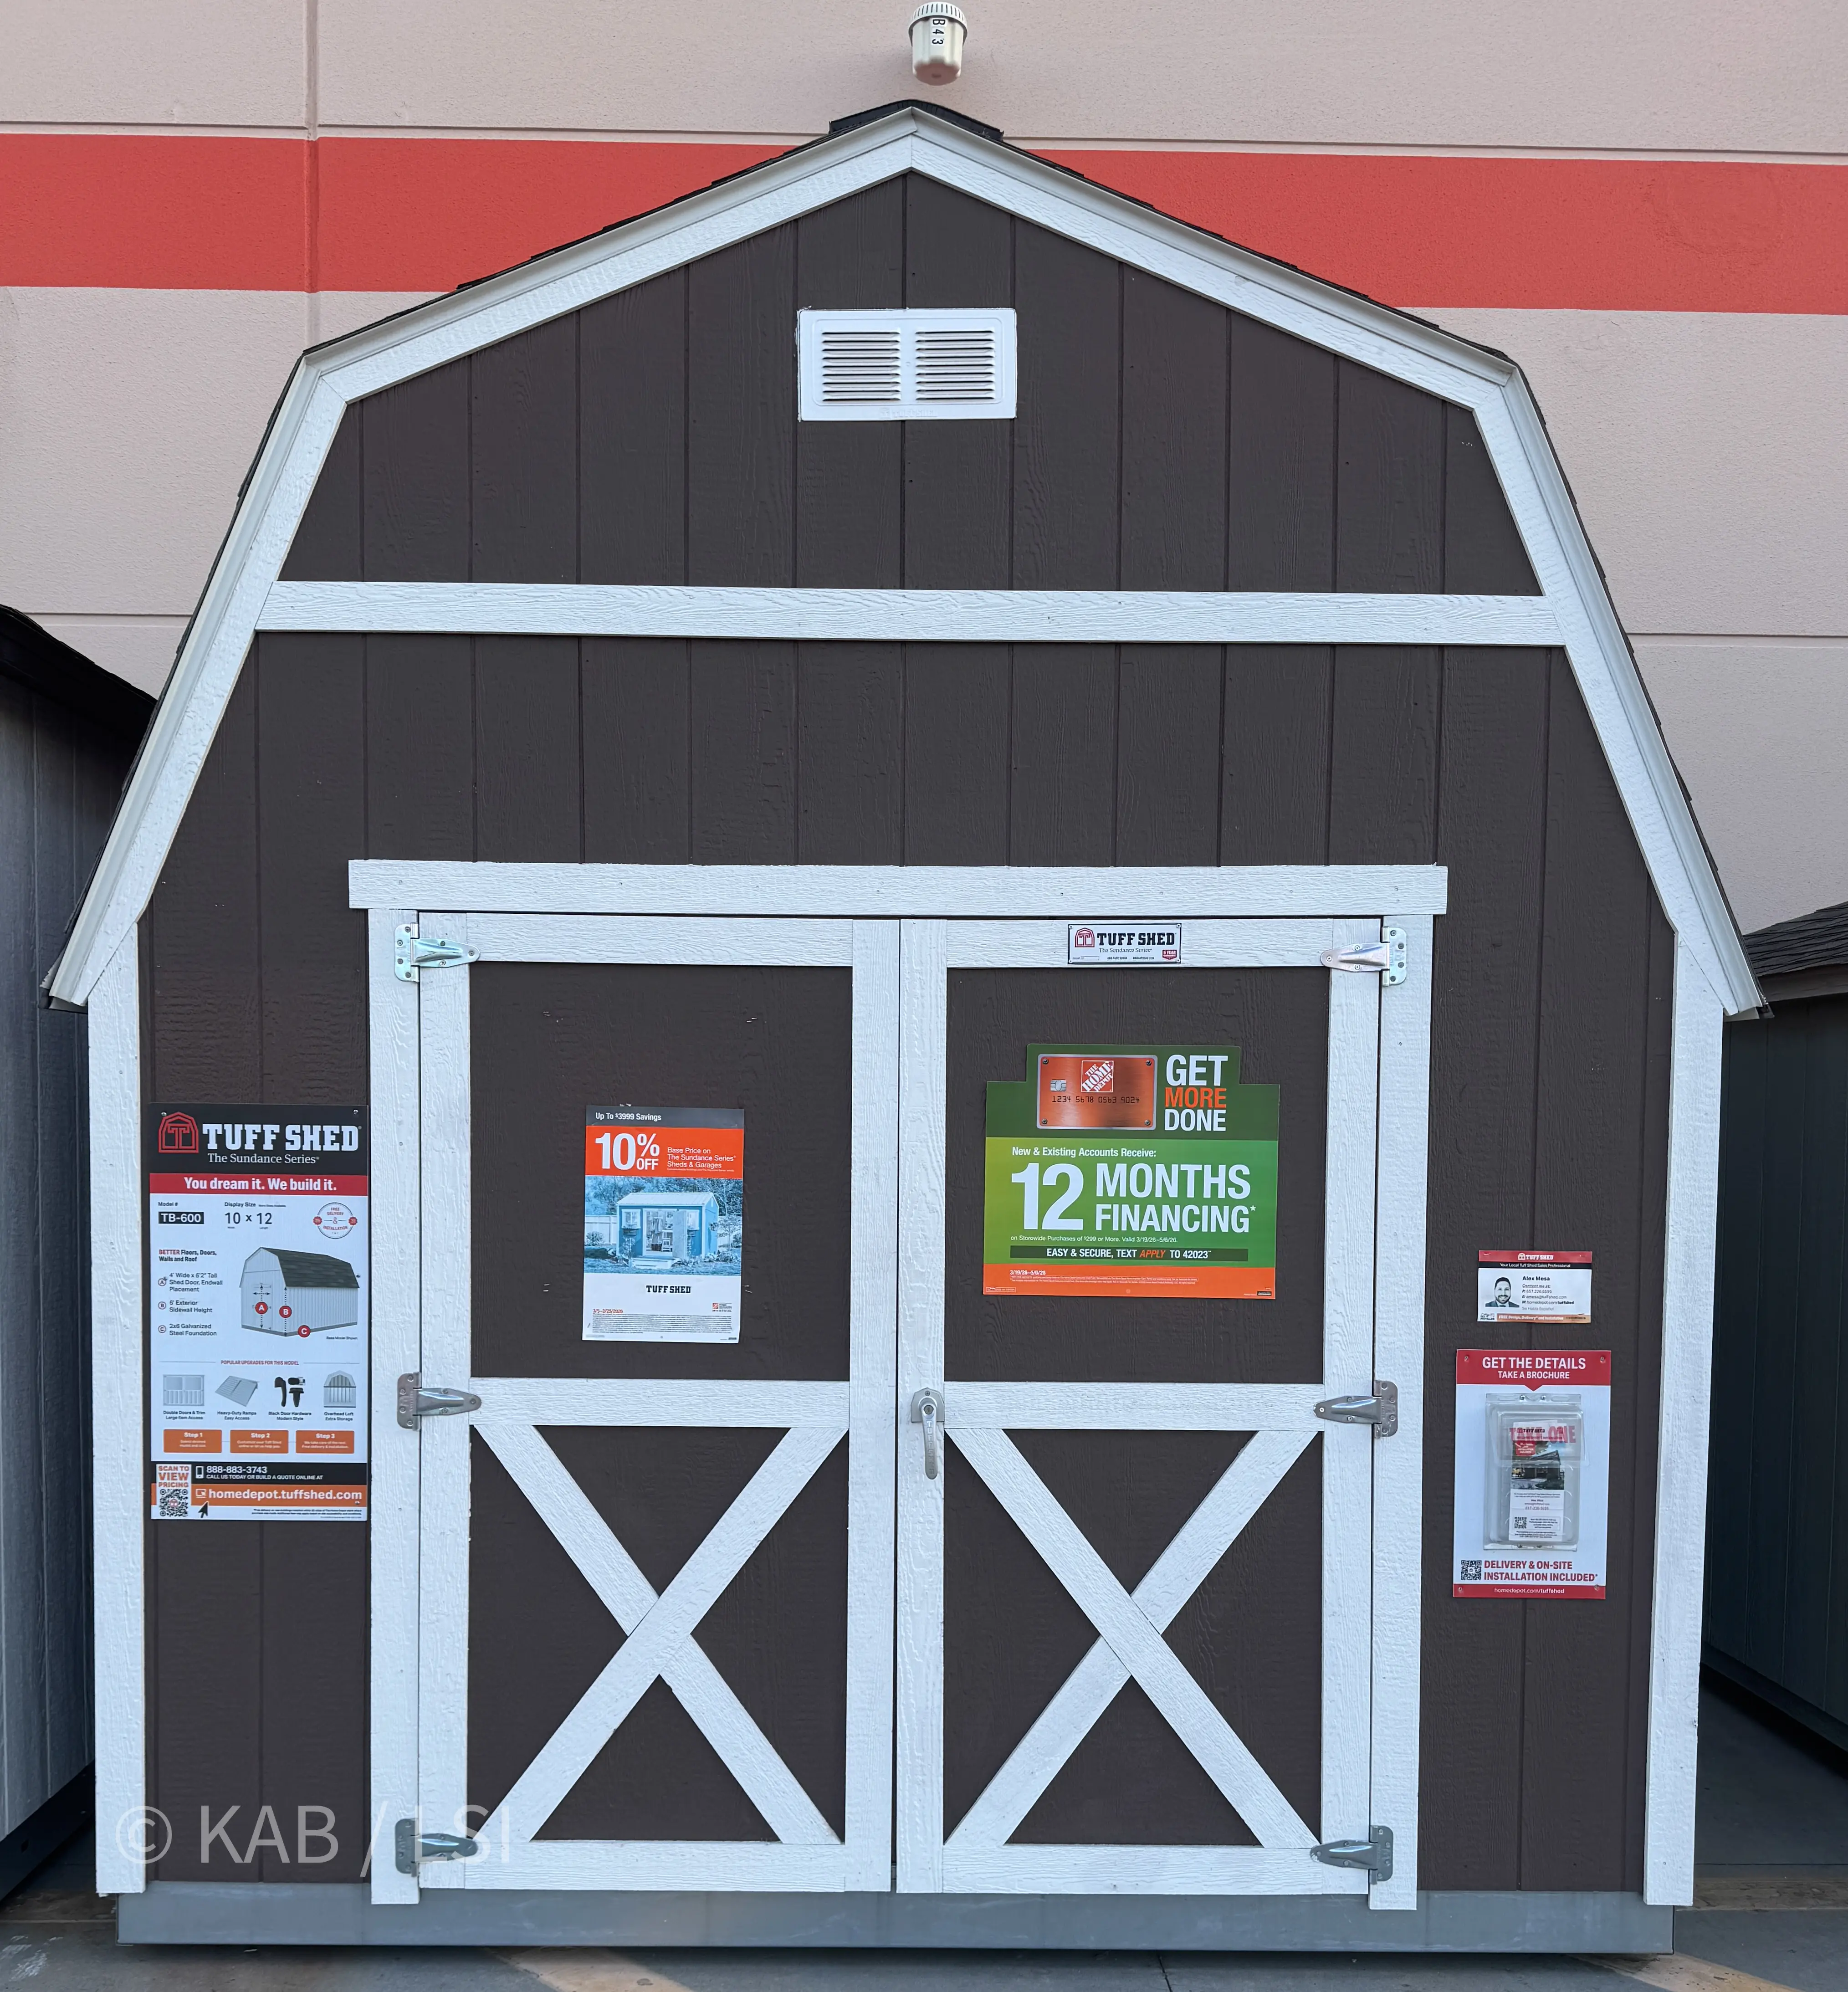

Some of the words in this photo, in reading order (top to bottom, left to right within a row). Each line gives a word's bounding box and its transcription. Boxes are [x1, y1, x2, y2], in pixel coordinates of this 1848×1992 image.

[932, 19, 946, 45] B43
[1097, 932, 1135, 946] TUFF
[1138, 932, 1175, 946] SHED
[1081, 1061, 1114, 1092] HOME
[1085, 1064, 1099, 1077] THE
[1166, 1055, 1228, 1086] GET
[1093, 1071, 1114, 1092] DEPOT
[1165, 1087, 1227, 1108] MORE
[636, 1113, 662, 1121] Savings
[1165, 1109, 1226, 1131] DONE
[203, 1123, 280, 1150] TUFF
[285, 1125, 358, 1152] SHED
[595, 1132, 660, 1170] 10%
[1012, 1147, 1031, 1156] New
[1033, 1147, 1040, 1156] &
[1042, 1147, 1076, 1158] Existing
[1078, 1147, 1119, 1157] Accounts
[1121, 1148, 1157, 1157] Receive:
[208, 1153, 228, 1163] The
[230, 1153, 282, 1163] Sundance
[636, 1158, 659, 1170] OFF
[184, 1177, 208, 1189] You
[210, 1178, 249, 1190] dream
[251, 1178, 265, 1190] it.
[267, 1178, 288, 1190] We
[290, 1178, 321, 1191] build
[323, 1179, 337, 1191] it.
[1096, 1163, 1251, 1200] MONTHS
[1011, 1162, 1085, 1230] 12
[160, 1213, 201, 1223] TB-600
[225, 1212, 241, 1224] 10
[256, 1212, 272, 1224] 12
[1047, 1248, 1068, 1257] EASY
[1070, 1249, 1077, 1257] &
[1079, 1249, 1113, 1259] SECURE,
[1116, 1249, 1137, 1258] TEXT
[1139, 1249, 1166, 1258] APPLY
[1170, 1250, 1180, 1258] TO
[646, 1285, 668, 1293] TUFF
[670, 1285, 691, 1294] SHED
[1482, 1357, 1506, 1368] GET
[1508, 1357, 1532, 1369] THE
[1536, 1357, 1586, 1369] DETAILS
[1548, 1425, 1576, 1444] ONE
[158, 1472, 189, 1481] VIEW
[209, 1489, 362, 1501] homedepot.tuffshed.com
[1484, 1560, 1527, 1569] DELIVERY
[1528, 1561, 1535, 1569] &
[1536, 1561, 1572, 1570] ON-SITE
[1484, 1572, 1548, 1581] INSTALLATION
